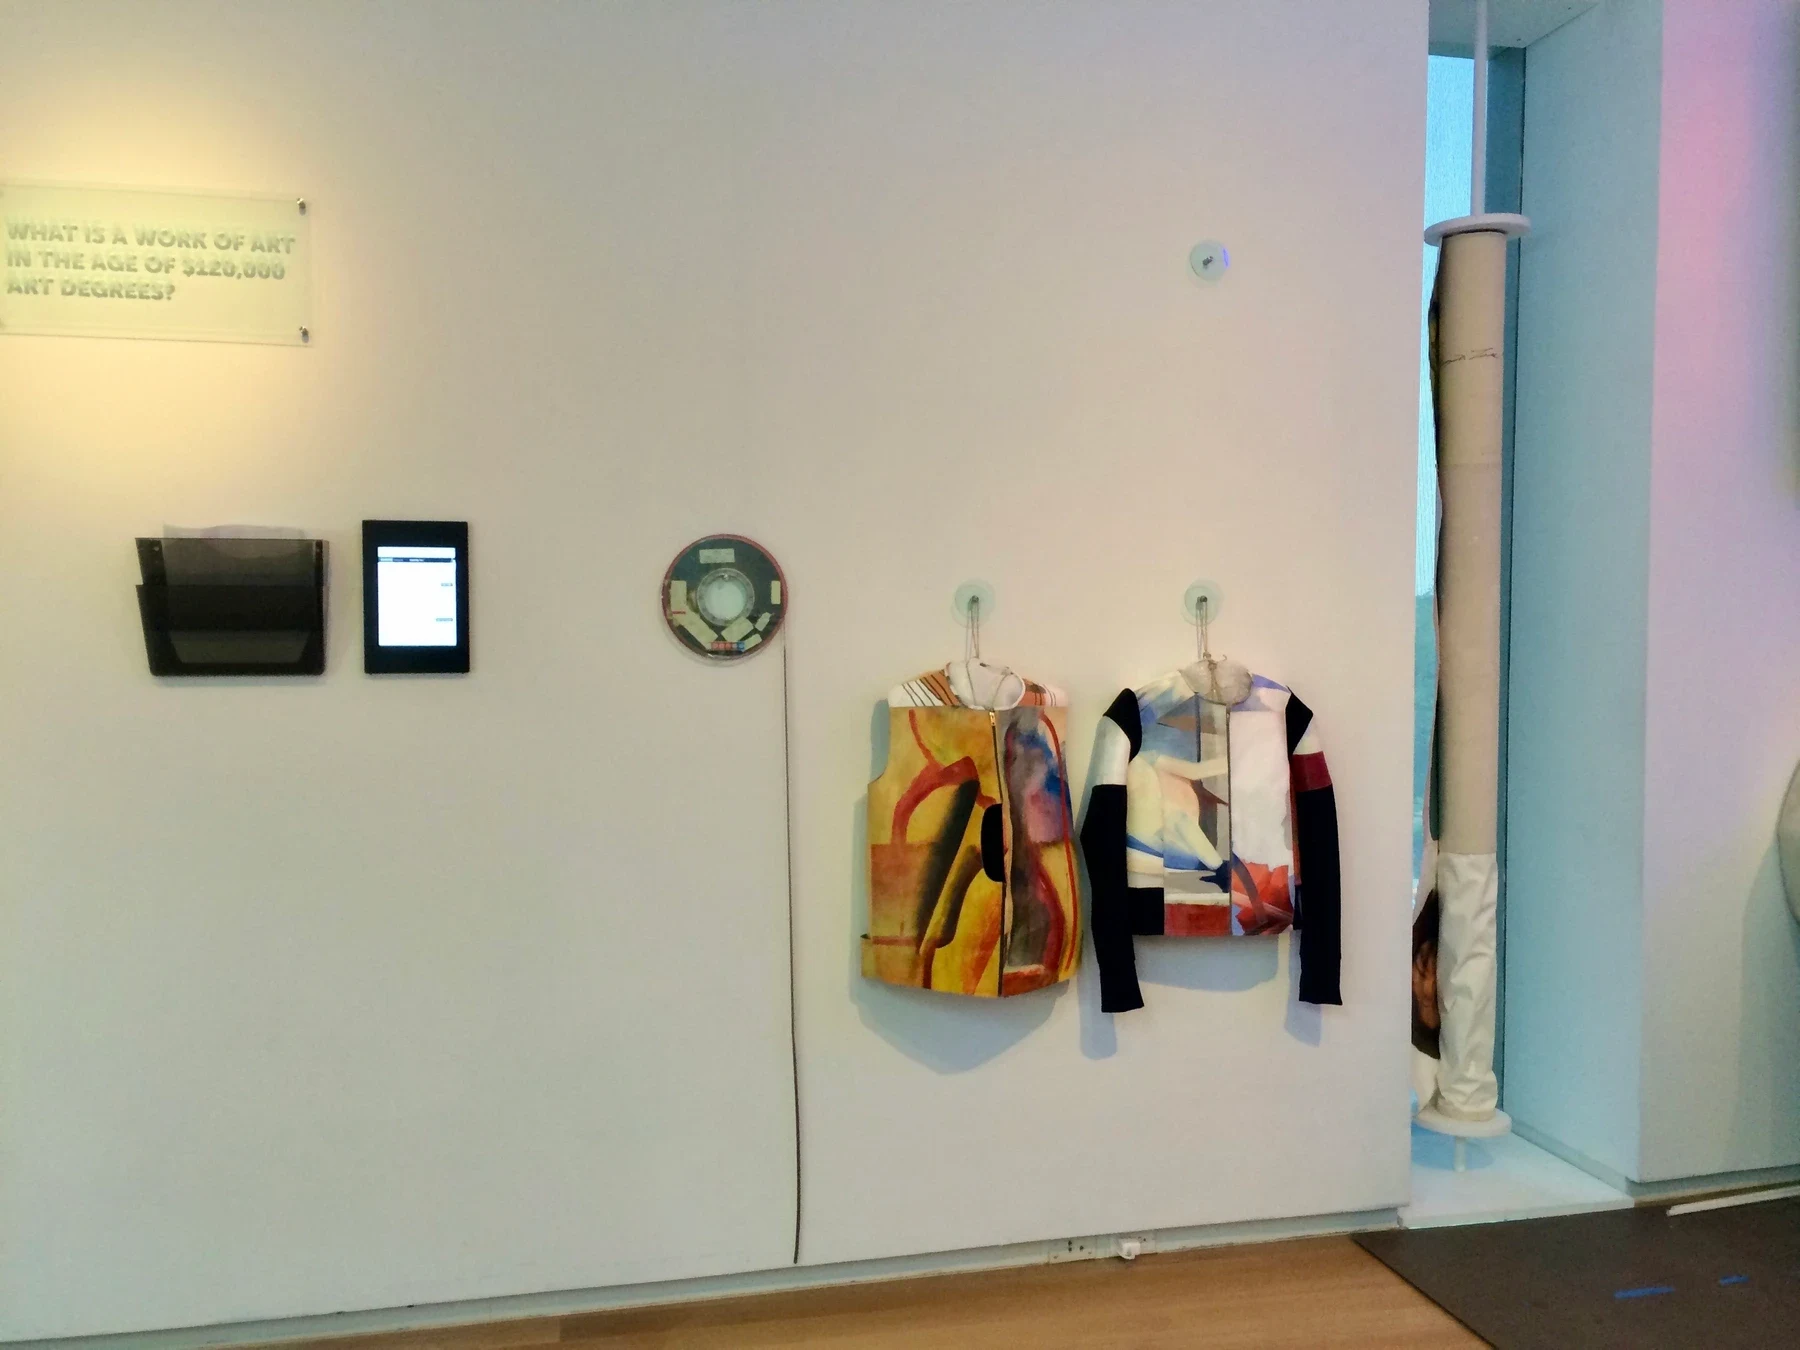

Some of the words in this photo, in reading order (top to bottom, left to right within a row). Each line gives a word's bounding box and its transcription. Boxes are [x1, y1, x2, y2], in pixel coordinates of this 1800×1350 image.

[7, 220, 78, 242] WHAT
[84, 224, 105, 244] IS
[112, 226, 128, 246] A
[134, 226, 207, 250] WORK
[213, 231, 244, 251] OF
[250, 232, 295, 254] ART
[7, 248, 31, 268] IN
[38, 250, 85, 270] THE
[91, 252, 138, 273] AGE
[144, 254, 176, 274] OF
[182, 255, 285, 280] $120,000
[7, 276, 54, 296] ART
[60, 278, 175, 300] DEGREES?
